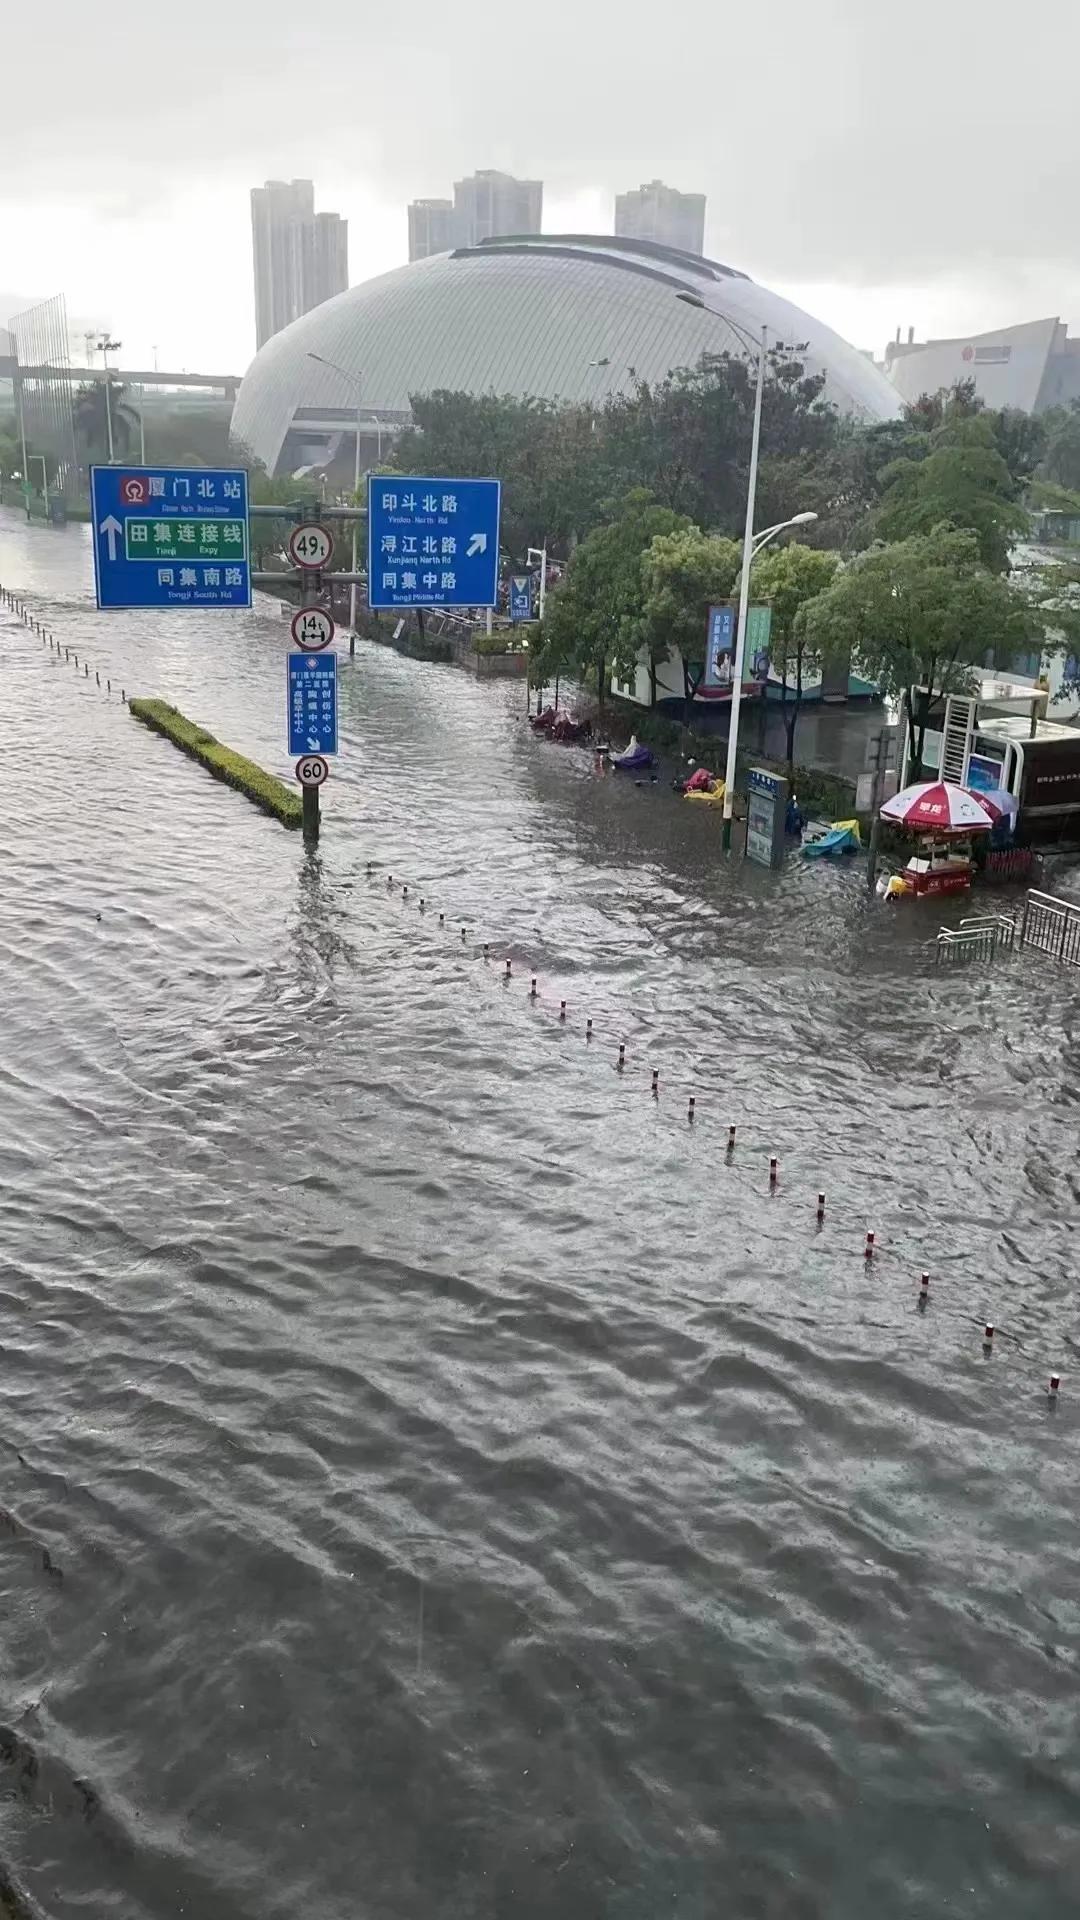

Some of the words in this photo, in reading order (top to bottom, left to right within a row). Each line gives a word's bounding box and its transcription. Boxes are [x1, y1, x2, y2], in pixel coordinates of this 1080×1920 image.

[148, 477, 241, 498] 厦门北站
[382, 493, 457, 512] 印斗北路
[131, 523, 242, 543] 田集连接线
[381, 535, 457, 553] 浔江北路
[420, 556, 440, 564] North
[442, 556, 451, 564] Rd
[158, 567, 242, 586] 同集南路
[382, 572, 456, 589] 同集中路
[303, 763, 321, 778] 60
